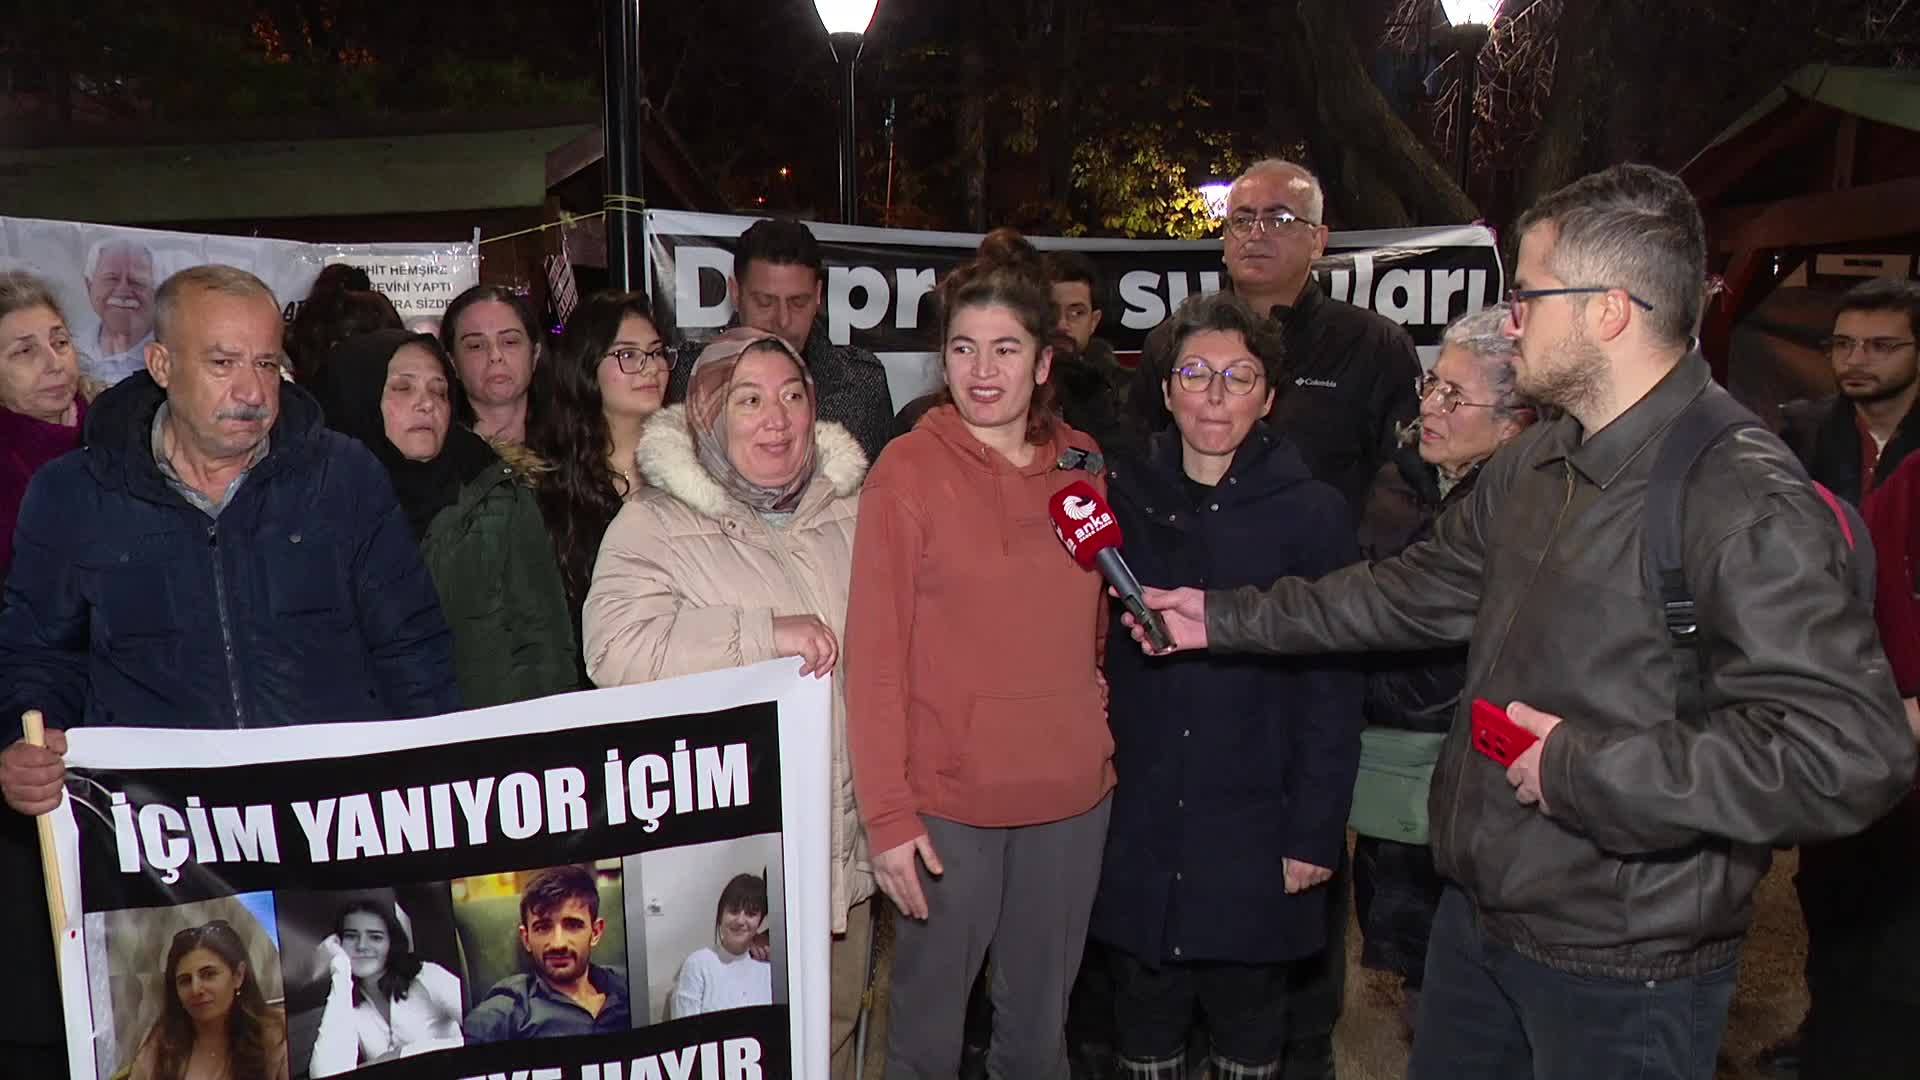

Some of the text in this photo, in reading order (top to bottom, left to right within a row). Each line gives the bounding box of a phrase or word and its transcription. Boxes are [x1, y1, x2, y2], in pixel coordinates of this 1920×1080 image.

[413, 281, 452, 293] YAPTI
[1074, 512, 1112, 539] anka
[110, 738, 750, 884] İÇİM YANIYOR İÇİM
